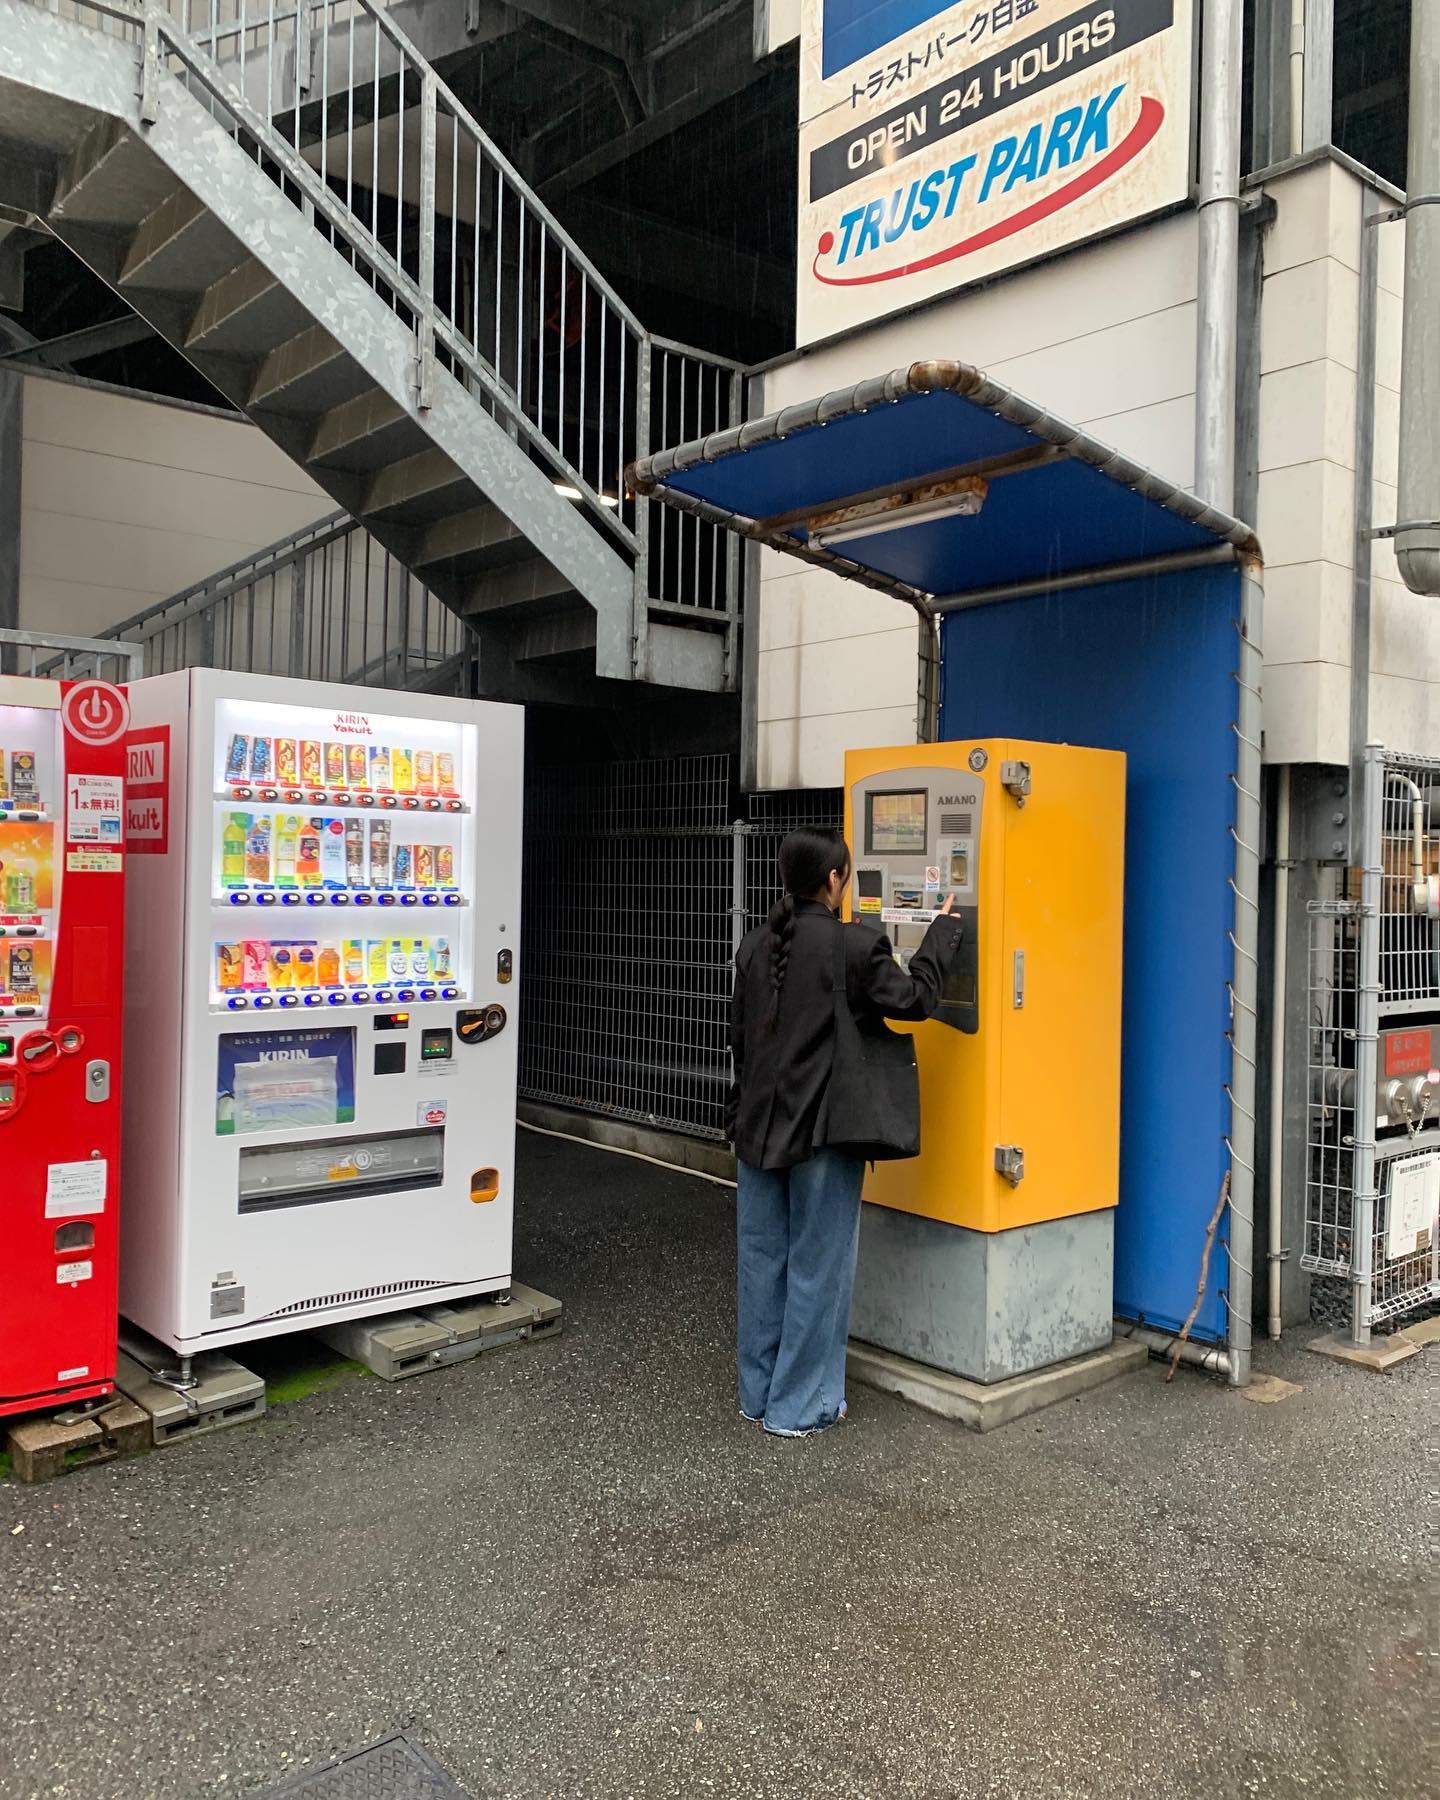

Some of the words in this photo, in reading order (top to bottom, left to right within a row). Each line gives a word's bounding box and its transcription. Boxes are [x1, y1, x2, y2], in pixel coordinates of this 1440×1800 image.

[846, 105, 927, 171] OPEN
[939, 79, 984, 124] 24
[993, 9, 1117, 99] HOURS
[836, 155, 978, 266] TRUST
[978, 83, 1130, 204] PARK
[337, 714, 369, 726] KIRIN
[332, 723, 373, 735] Yakult
[937, 795, 977, 806] AMANO
[259, 1048, 309, 1064] KIRIN
